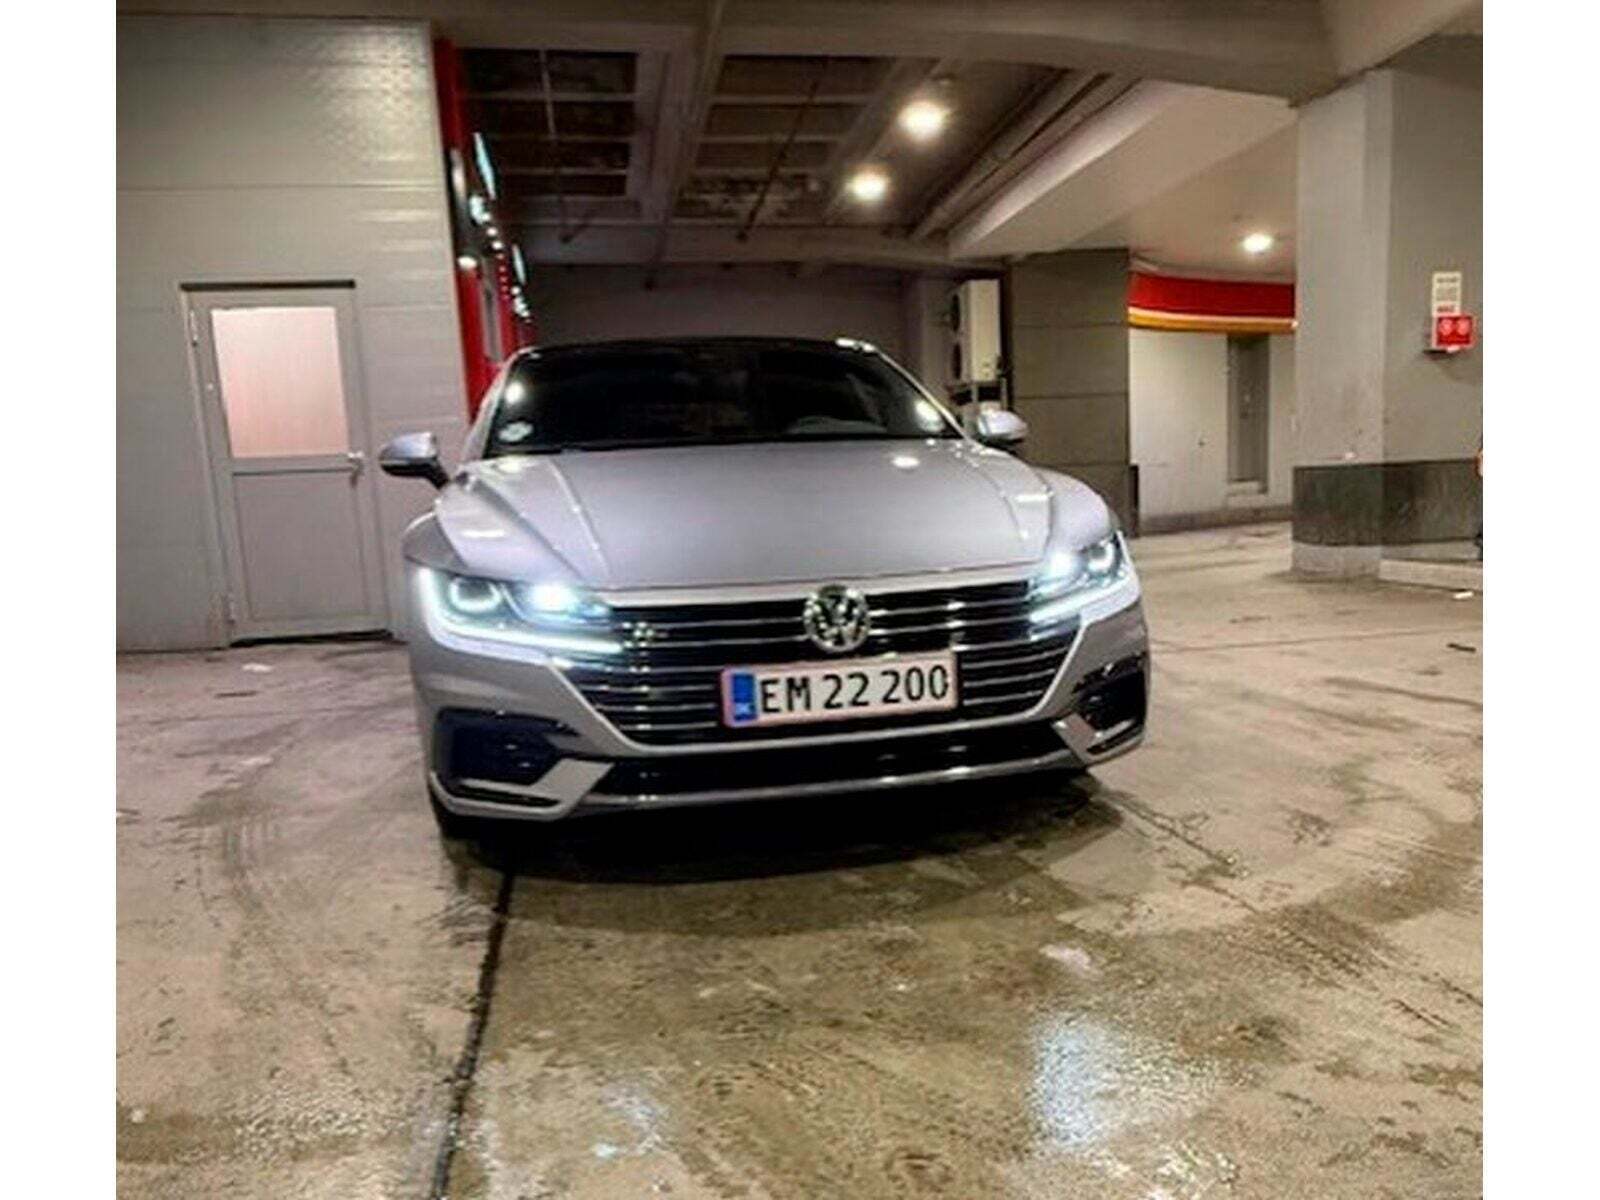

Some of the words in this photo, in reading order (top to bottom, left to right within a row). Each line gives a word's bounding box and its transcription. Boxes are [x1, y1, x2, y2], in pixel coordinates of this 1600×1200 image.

[760, 676, 812, 714] EM
[823, 672, 870, 710] 22
[880, 664, 949, 704] 200
